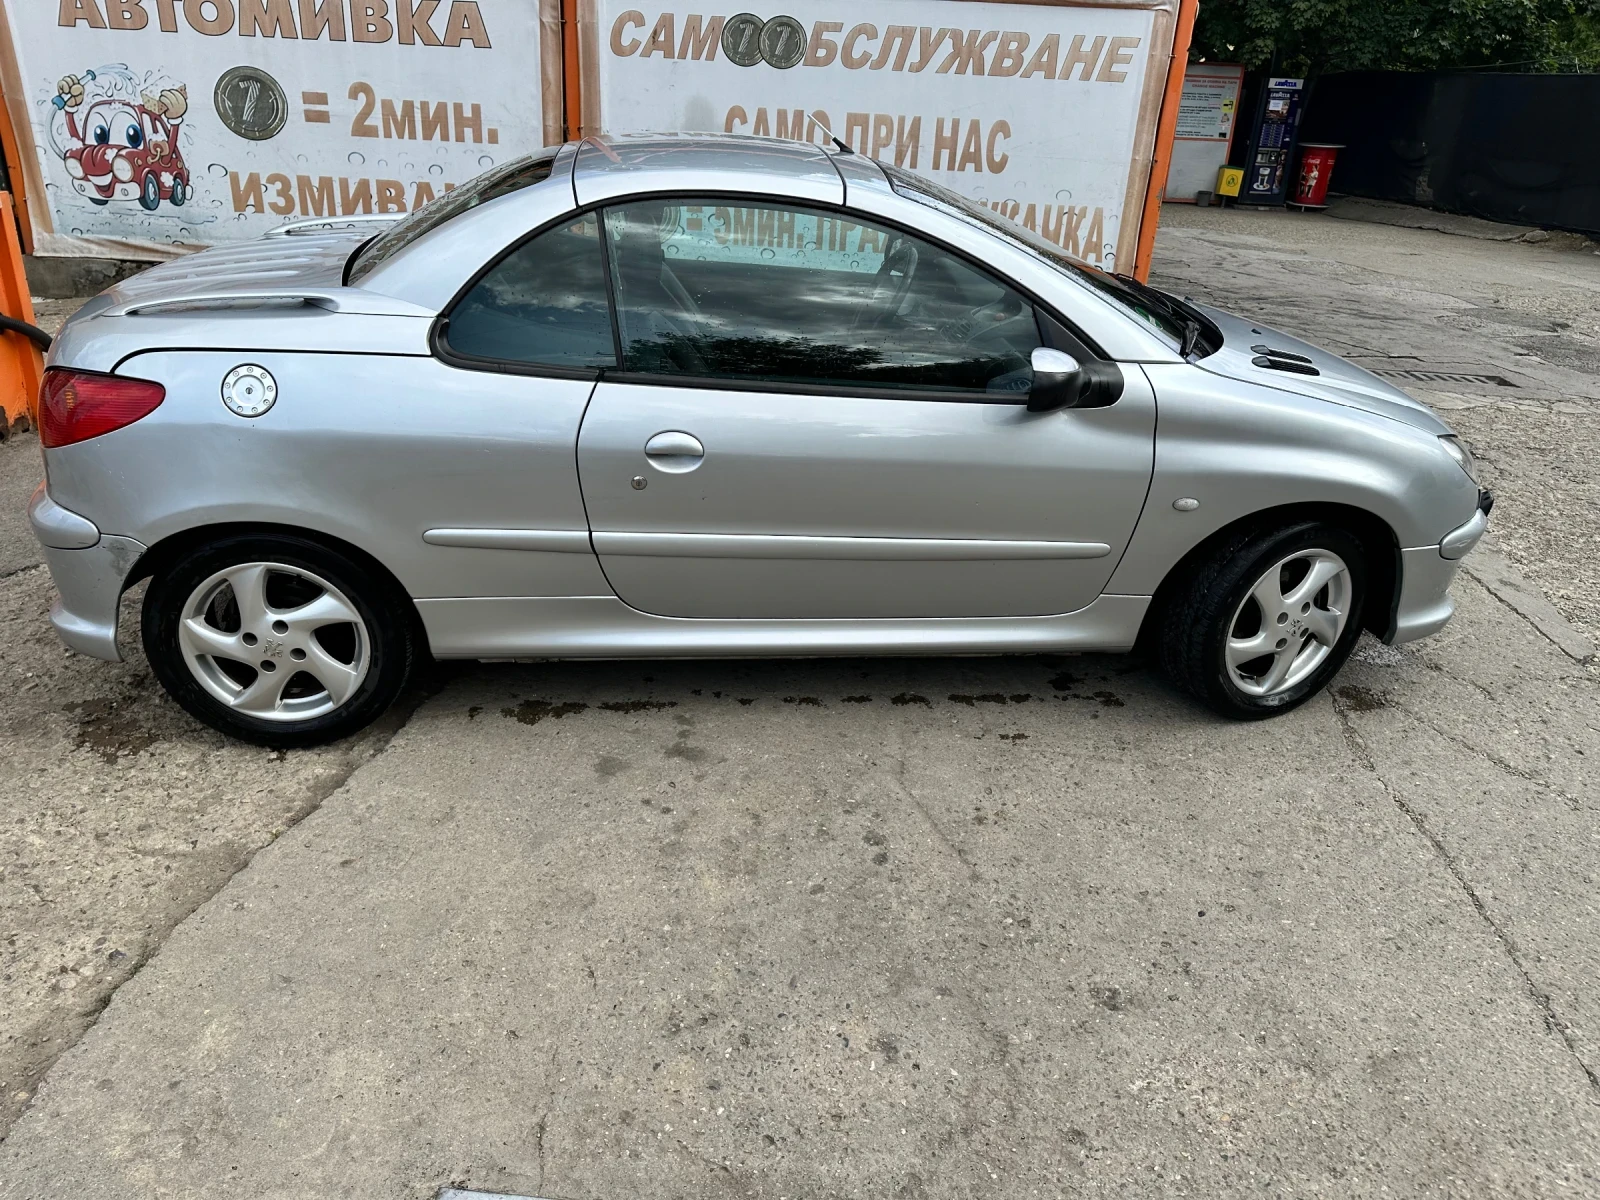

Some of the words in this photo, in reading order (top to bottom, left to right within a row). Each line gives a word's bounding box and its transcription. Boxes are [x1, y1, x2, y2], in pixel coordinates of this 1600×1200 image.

[57, 0, 492, 49] АВТОМИВКА
[845, 112, 922, 169] ПРИ
[931, 116, 1012, 174] НАС
